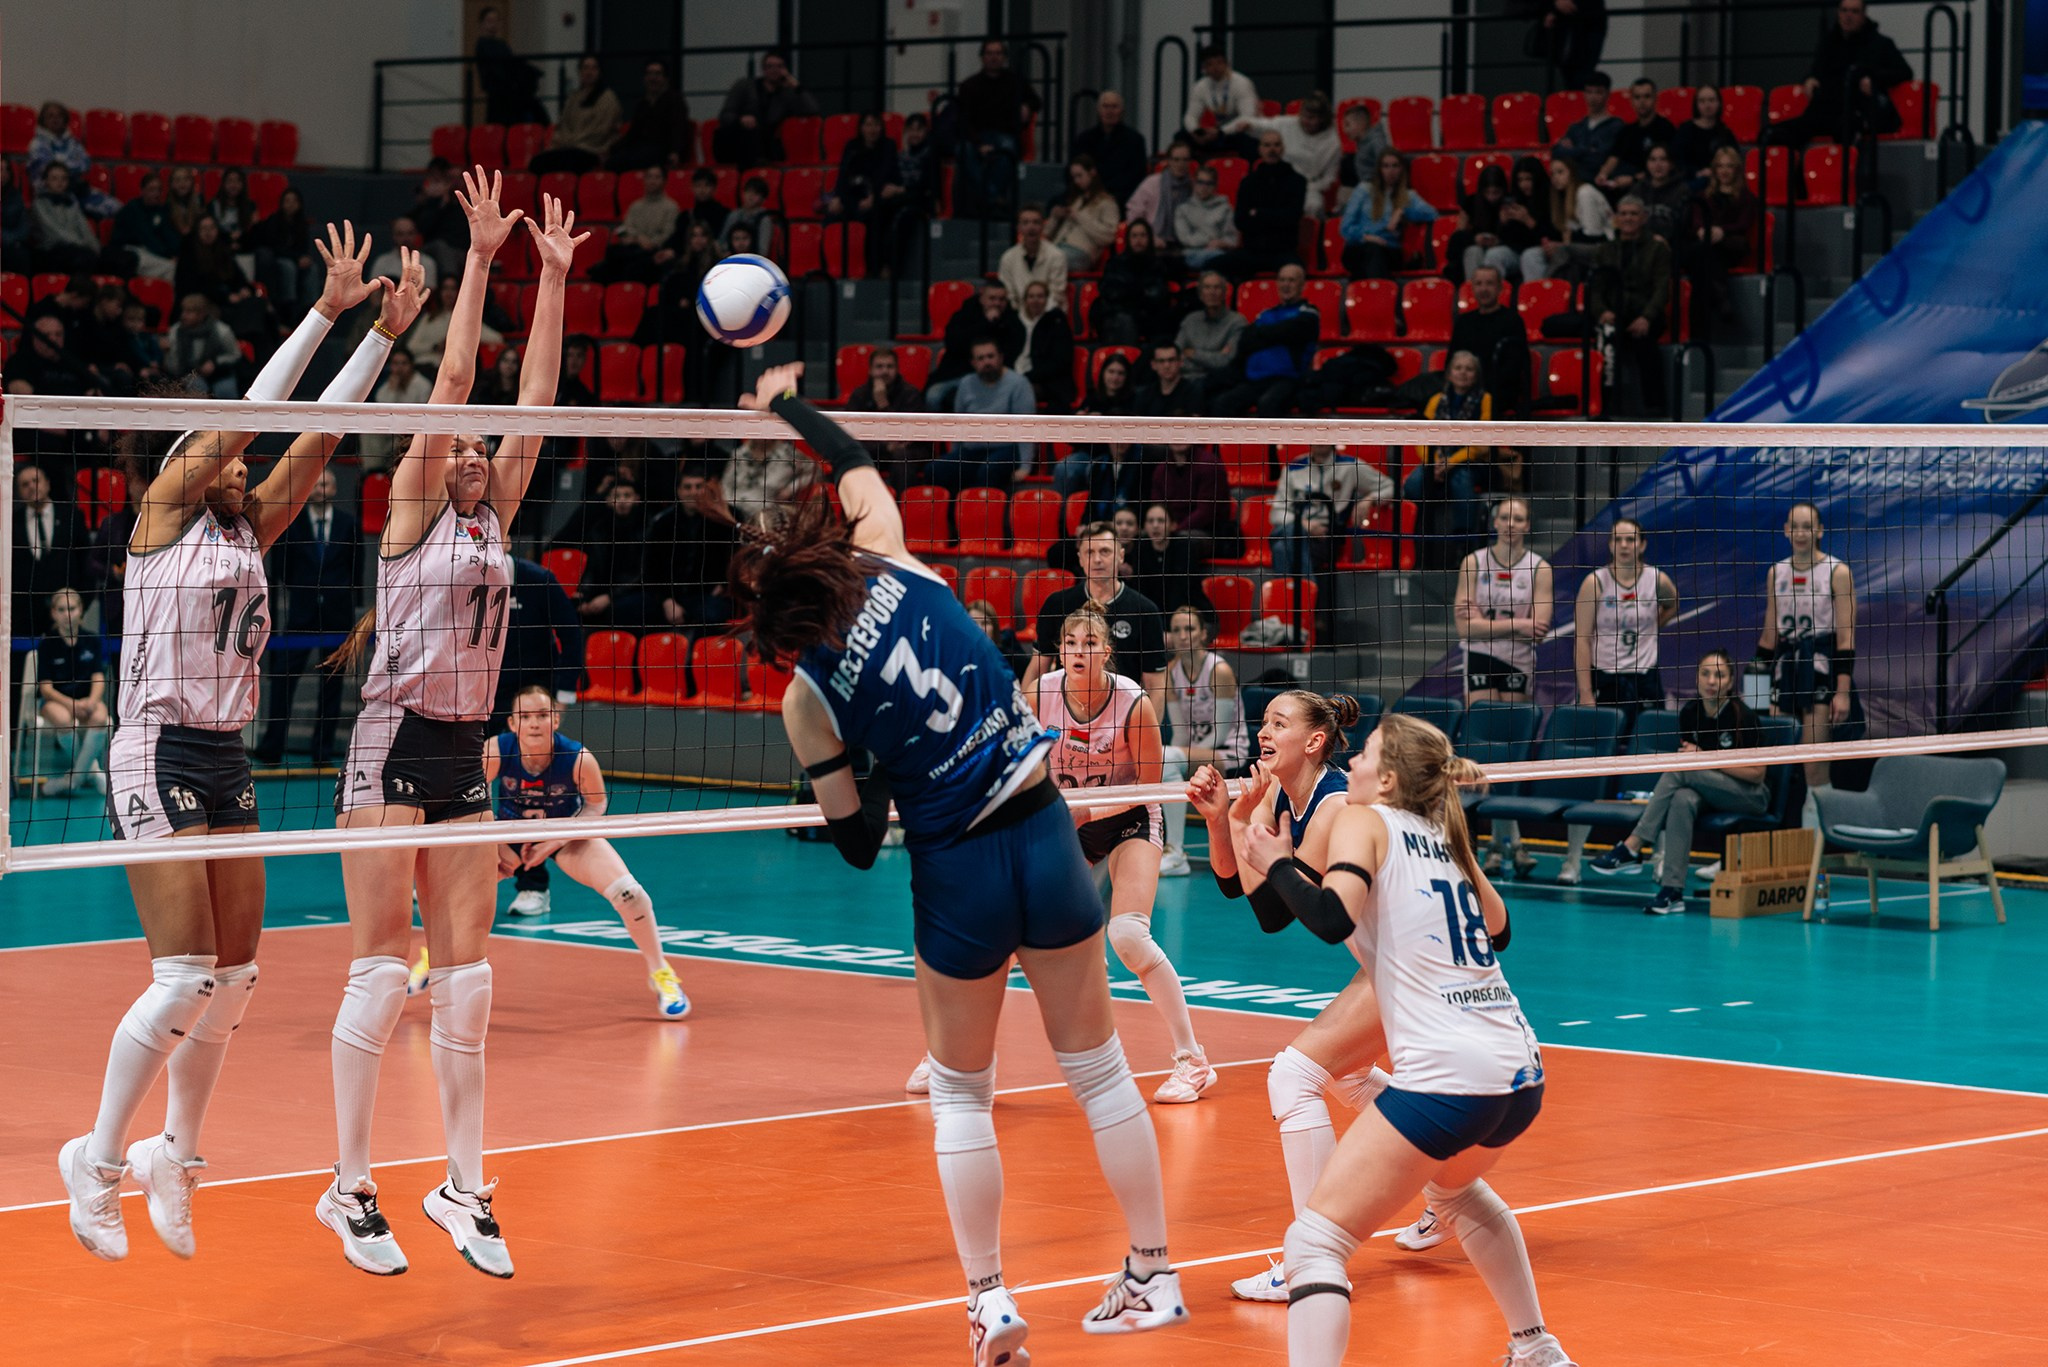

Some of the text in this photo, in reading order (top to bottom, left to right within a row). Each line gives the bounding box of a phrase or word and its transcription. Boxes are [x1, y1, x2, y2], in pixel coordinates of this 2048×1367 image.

[212, 587, 266, 659] 16
[466, 585, 508, 651] 11
[829, 573, 907, 702] НЕСТЕРОВА
[1621, 630, 1637, 656] 9
[1782, 615, 1813, 641] 22
[880, 636, 963, 733] 3
[1430, 879, 1495, 967] 18
